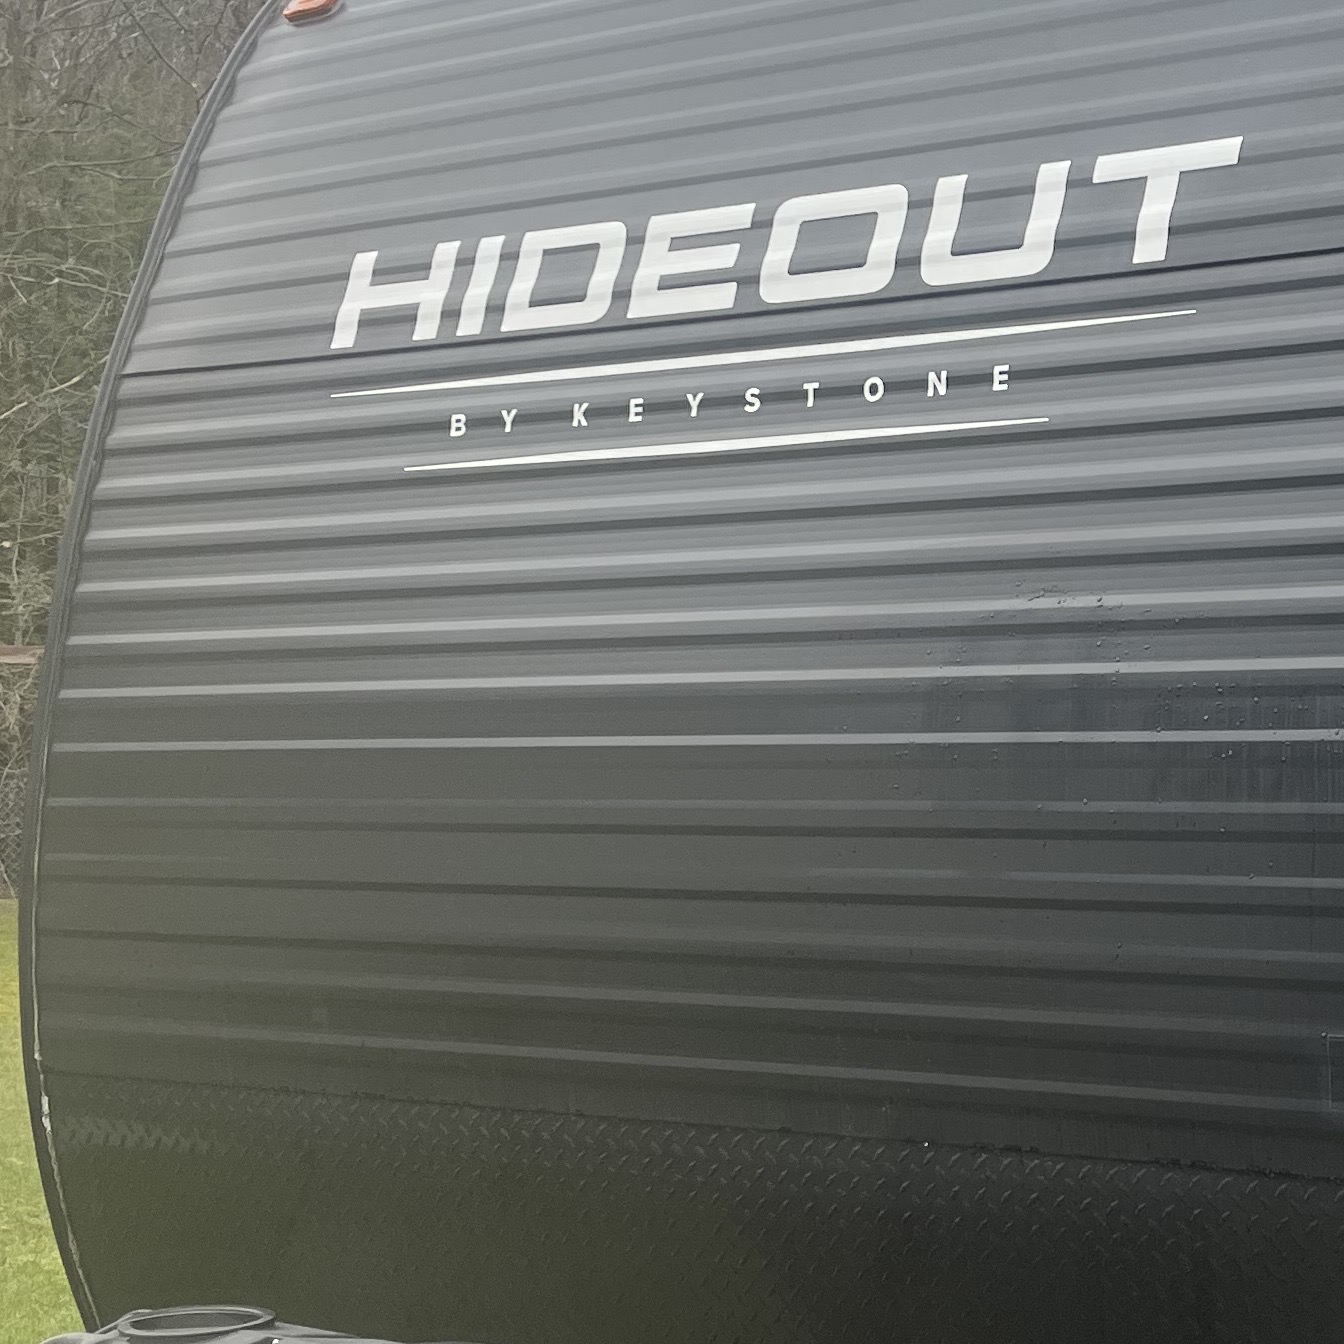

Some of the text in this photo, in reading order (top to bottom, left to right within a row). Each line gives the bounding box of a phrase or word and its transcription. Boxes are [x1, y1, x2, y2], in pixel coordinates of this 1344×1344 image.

[329, 135, 1244, 350] HIDEOUT
[449, 364, 1010, 437] BY KEYSTONE
